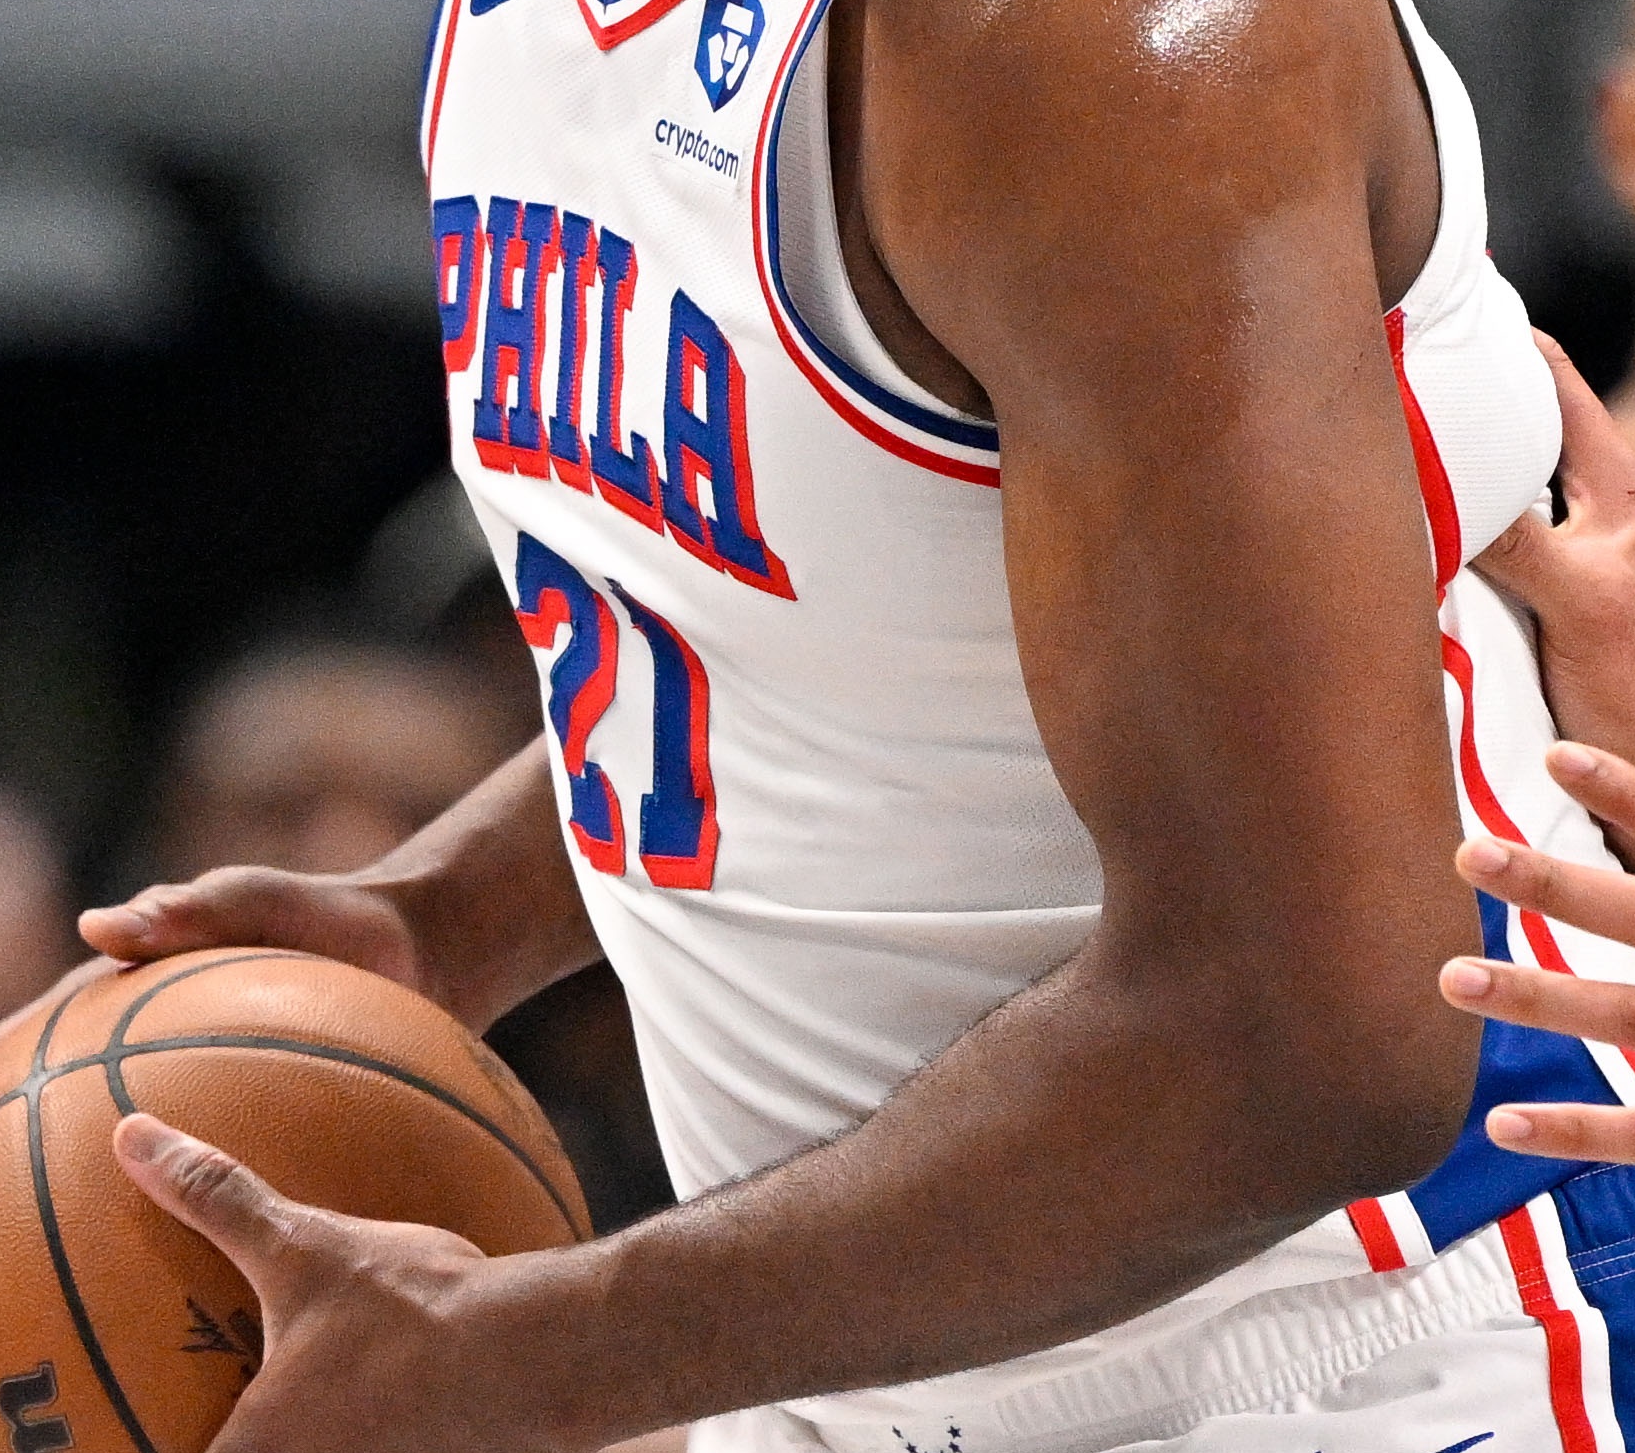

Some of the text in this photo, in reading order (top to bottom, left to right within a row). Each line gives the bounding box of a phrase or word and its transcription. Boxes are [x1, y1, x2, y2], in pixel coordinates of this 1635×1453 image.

[654, 117, 740, 180] crypto.com
[433, 194, 798, 601] PHILA
[514, 531, 718, 891] 21
